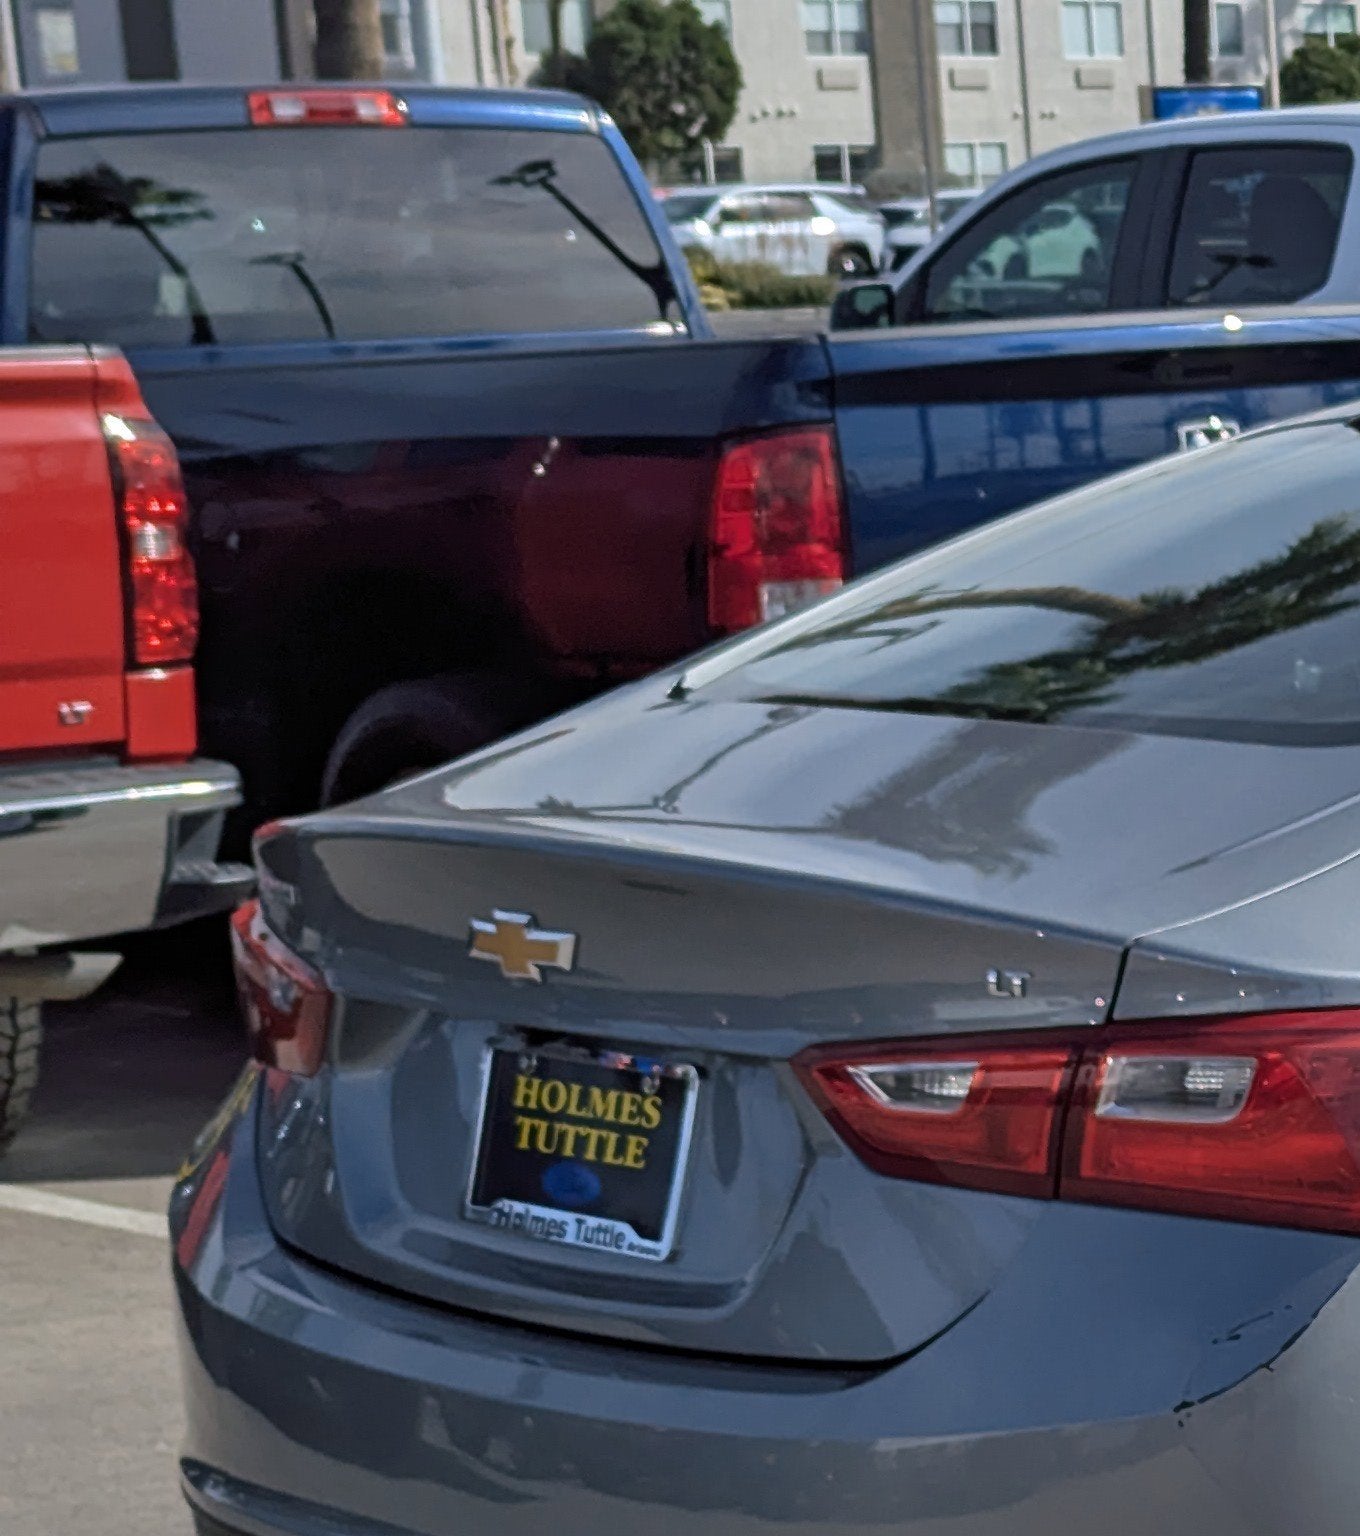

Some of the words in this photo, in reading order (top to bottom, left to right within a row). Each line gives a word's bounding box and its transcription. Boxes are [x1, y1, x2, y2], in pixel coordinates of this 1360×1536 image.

[985, 968, 1034, 998] LT
[512, 1074, 662, 1130] HOLMES
[515, 1115, 650, 1170] TUTTLE
[574, 1217, 627, 1250] Tuttle
